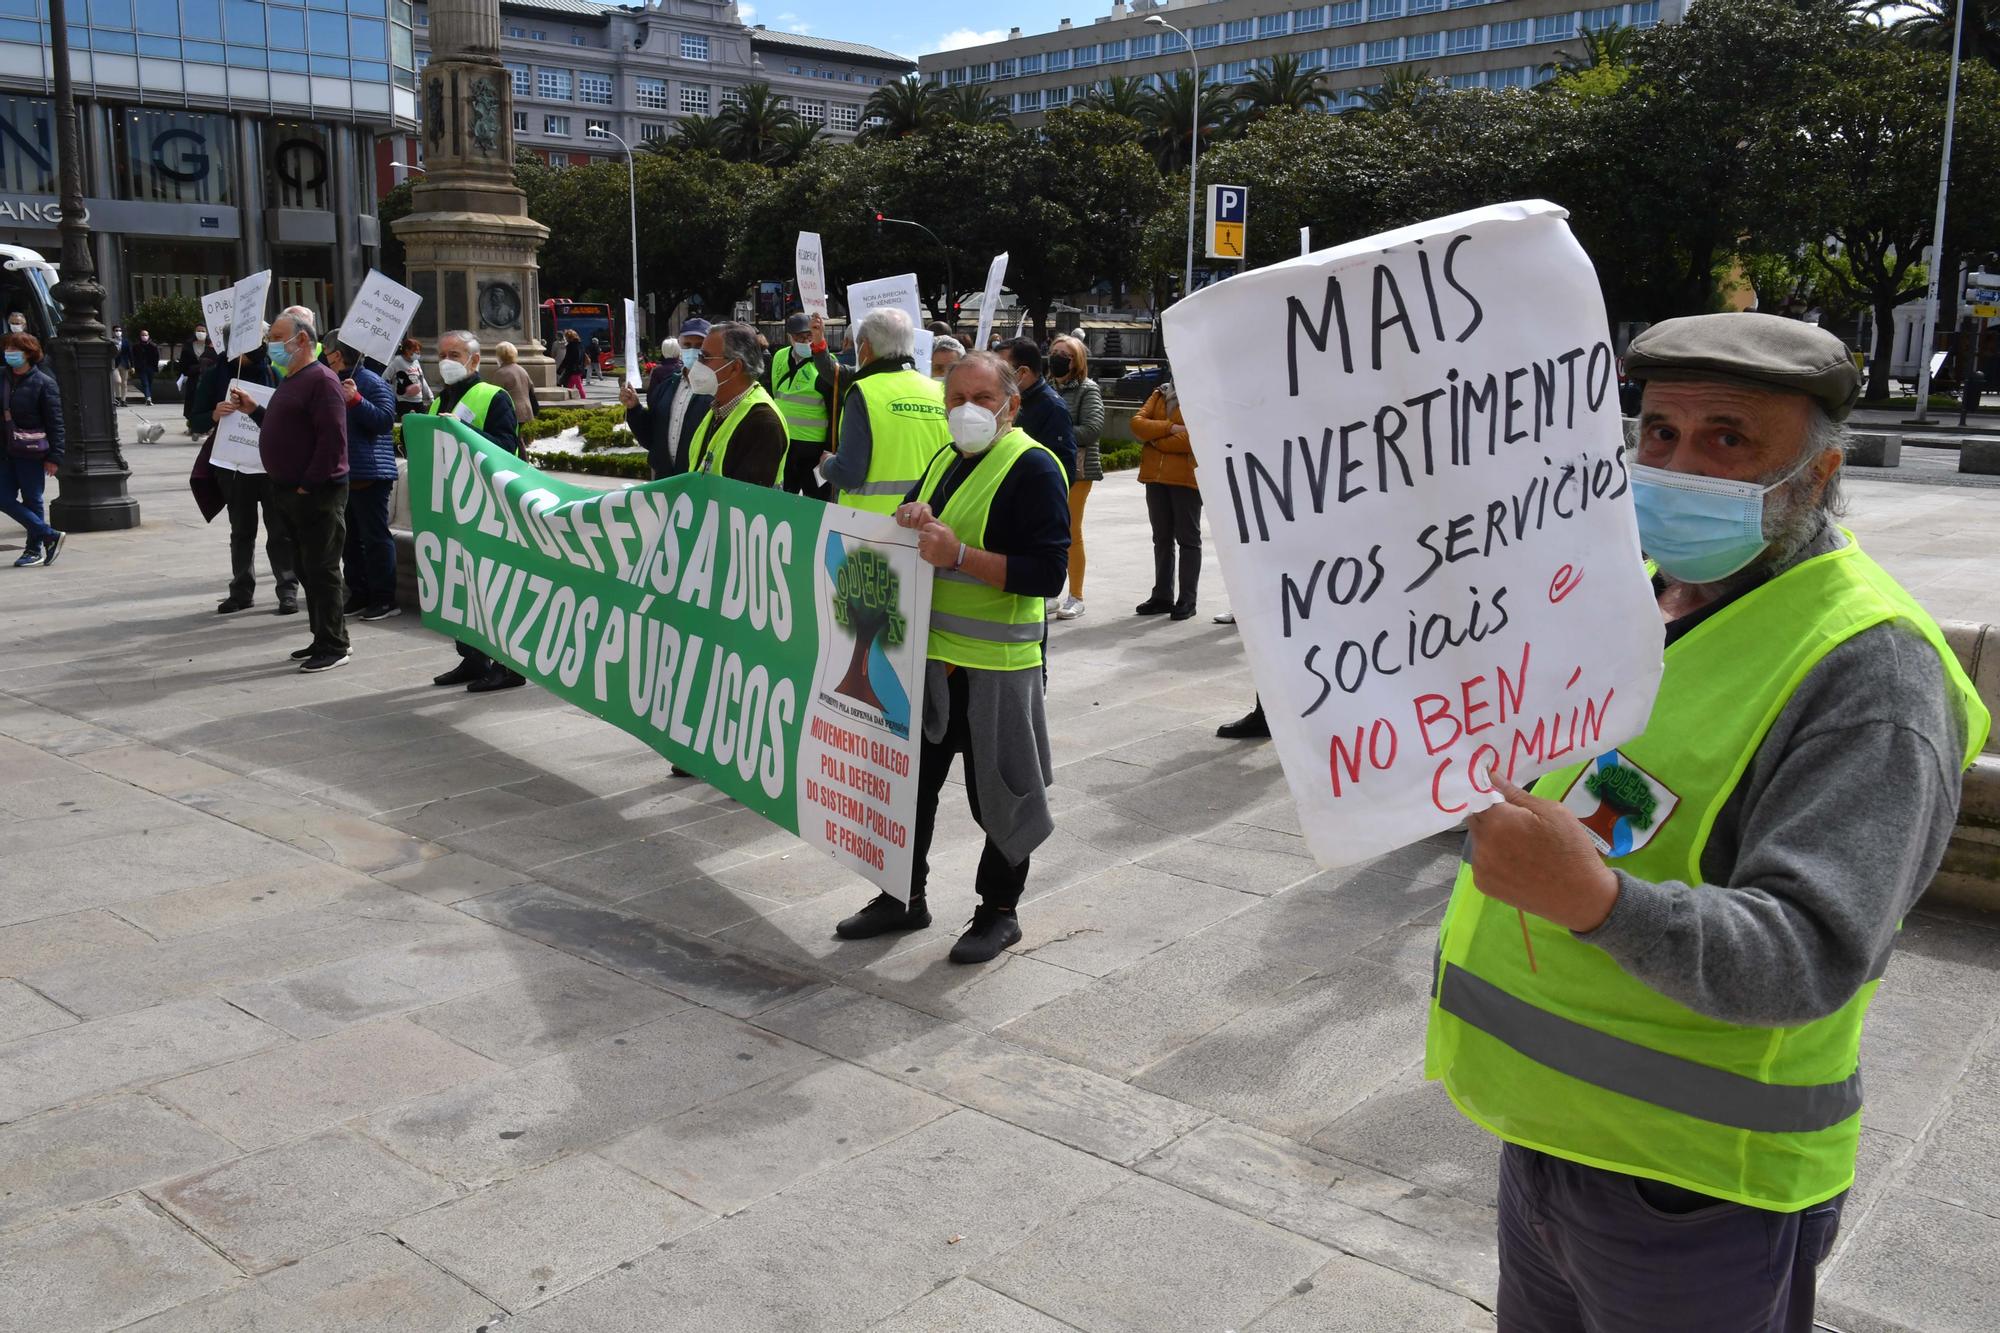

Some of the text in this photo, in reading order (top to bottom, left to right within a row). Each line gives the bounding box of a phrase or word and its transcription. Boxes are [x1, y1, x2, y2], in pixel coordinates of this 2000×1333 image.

[1222, 191, 1237, 218] P
[207, 304, 213, 314] O
[354, 317, 391, 341] IPC REAL
[382, 294, 405, 311] SUBA
[432, 429, 793, 642] POLA DEFENSA DOS
[833, 549, 906, 645] MODEPEN
[1282, 545, 1385, 637] NOS
[415, 531, 795, 799] SERVIZOS PÚBLICOS
[810, 715, 909, 778] MOVEMENTO GALEGO
[1330, 642, 1530, 797] NO BEN
[1432, 666, 1614, 813] COMÚN
[806, 778, 818, 801] DO
[820, 785, 864, 825] SISTEMA
[821, 753, 891, 805] POLA DEFENSA
[825, 819, 885, 871] DE PENSIÓNS
